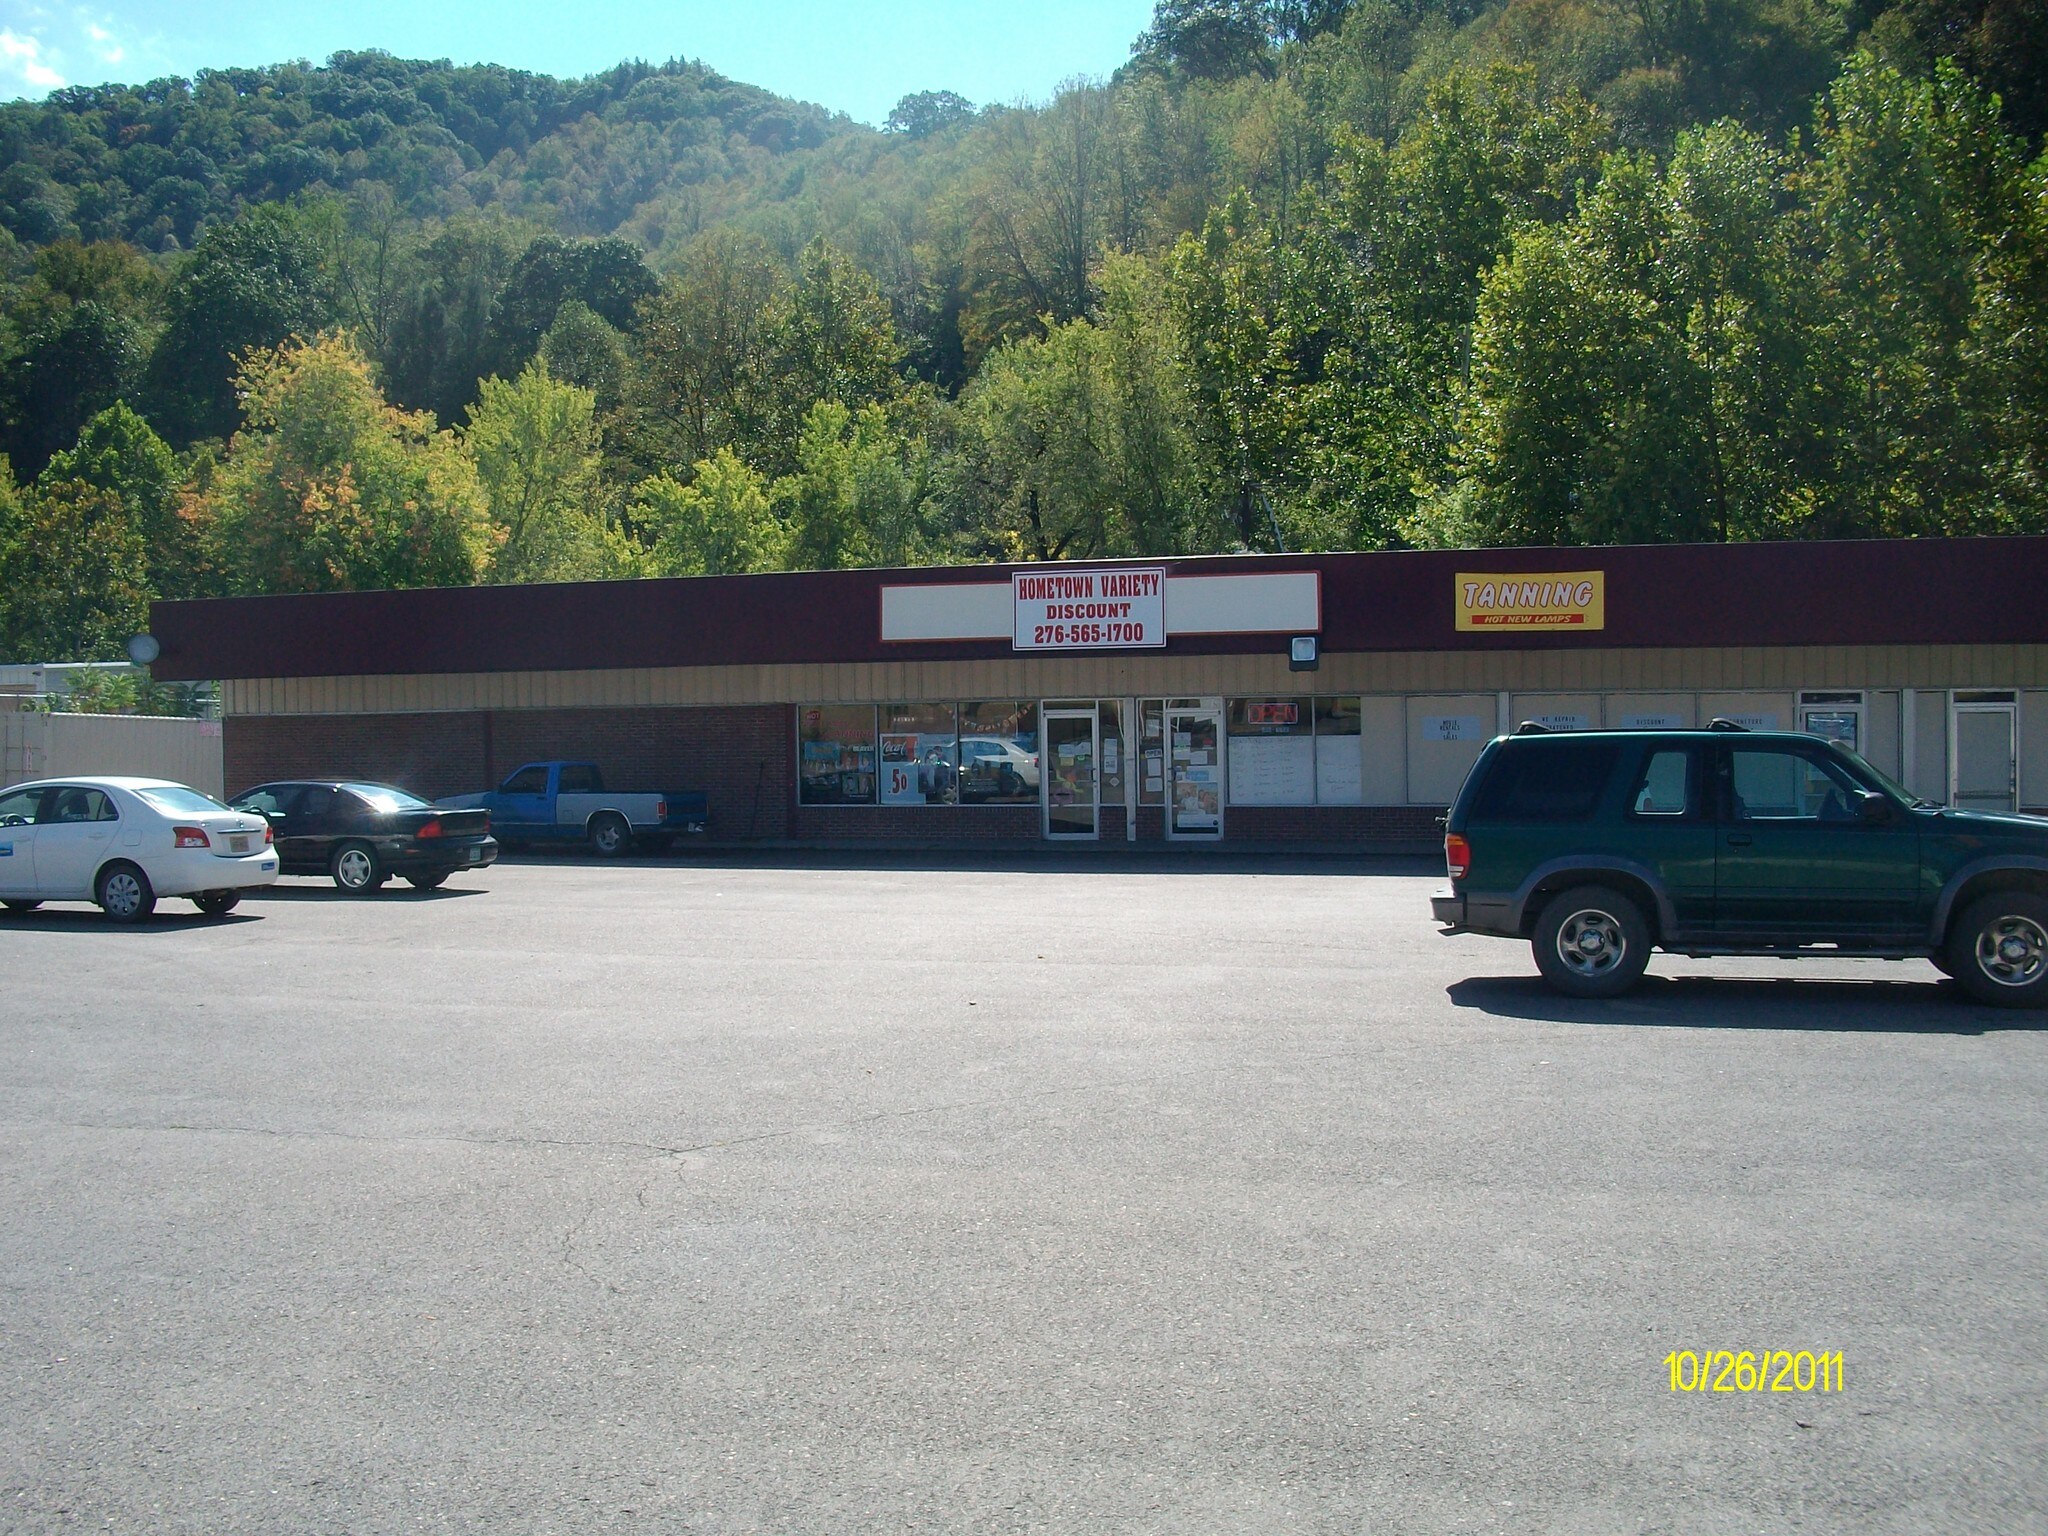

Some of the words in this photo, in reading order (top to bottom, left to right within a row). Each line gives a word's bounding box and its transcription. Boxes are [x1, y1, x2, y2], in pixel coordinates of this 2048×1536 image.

[1019, 576, 1093, 600] HOMETOWN
[1100, 574, 1159, 597] VARIETY
[1463, 580, 1593, 609] TANNING
[1046, 603, 1131, 619] DISCOUNT
[1484, 615, 1505, 623] HOT
[1507, 615, 1532, 623] NEW
[1534, 615, 1572, 623] LAMPS
[1034, 622, 1144, 644] 276-565-1700
[1250, 703, 1297, 723] OPEN
